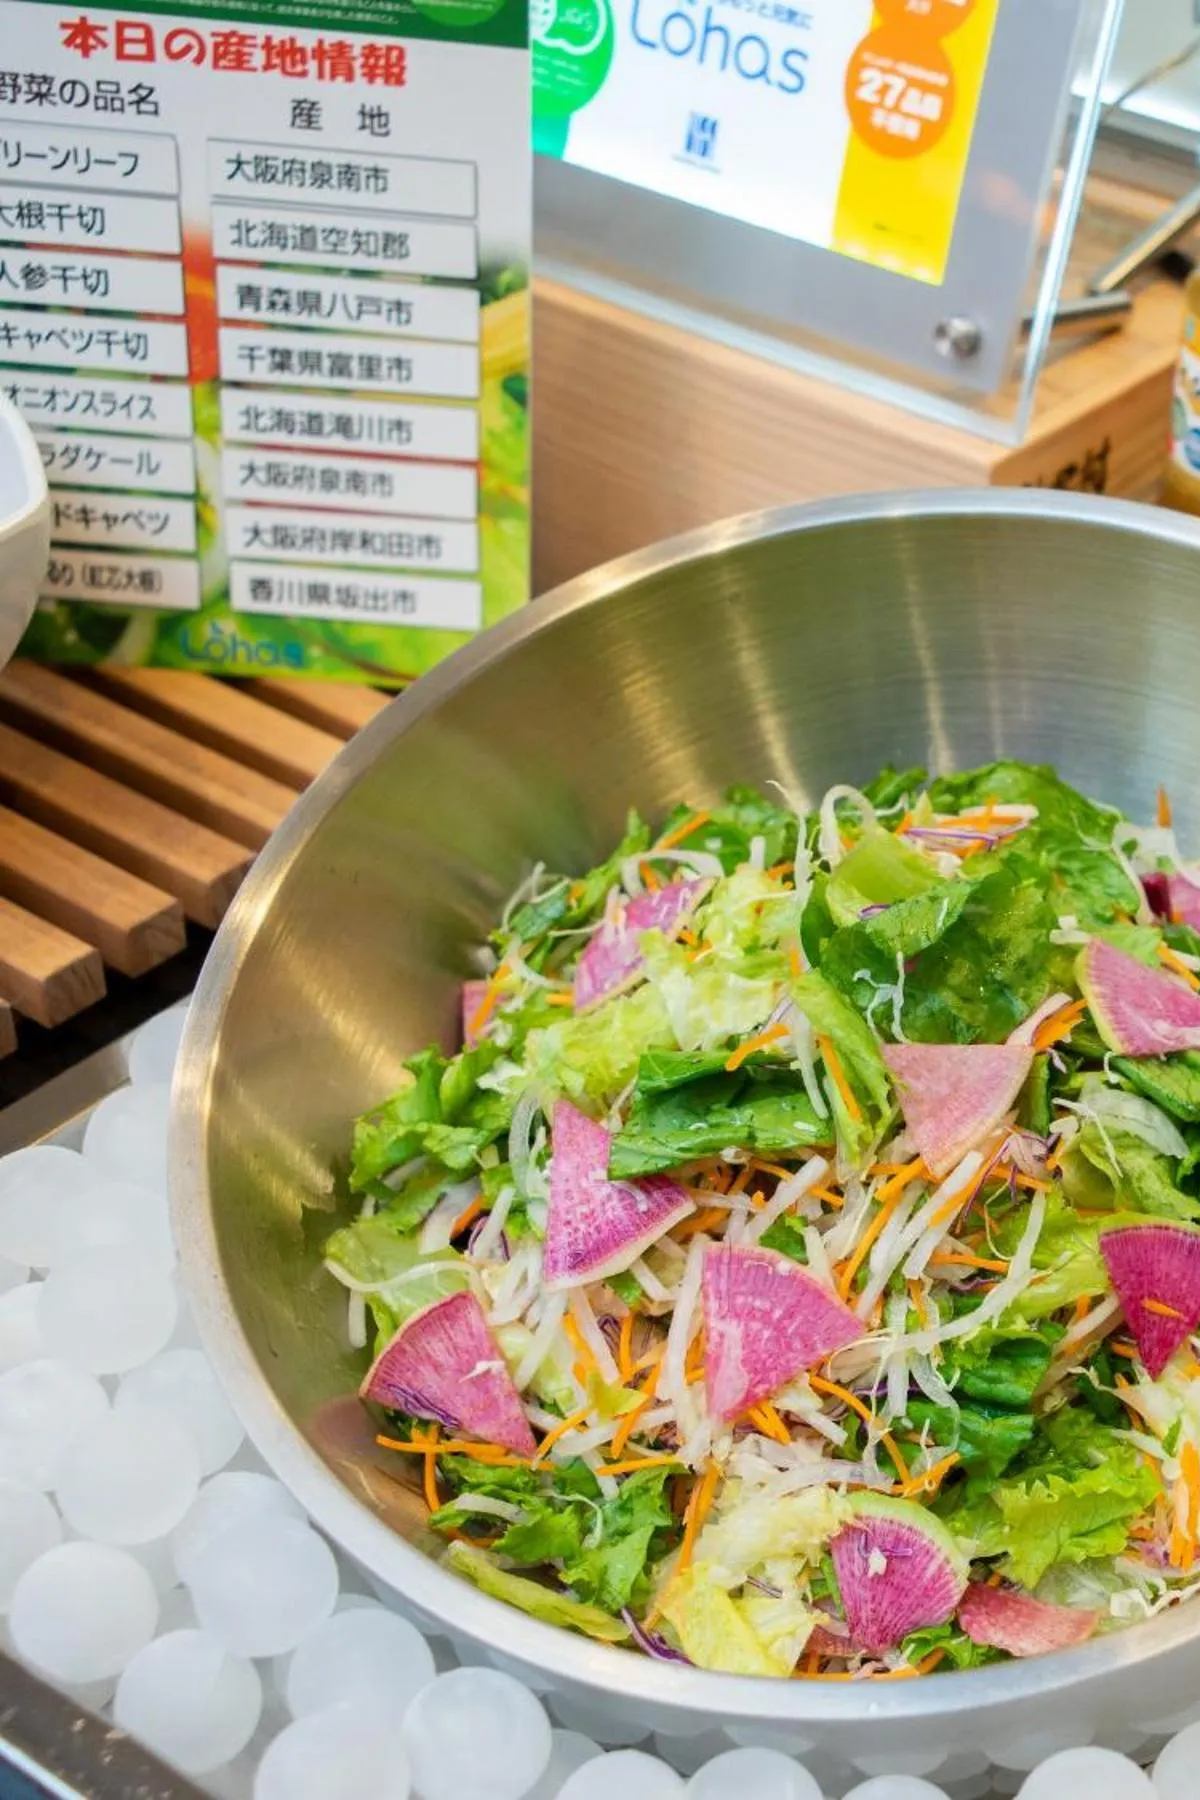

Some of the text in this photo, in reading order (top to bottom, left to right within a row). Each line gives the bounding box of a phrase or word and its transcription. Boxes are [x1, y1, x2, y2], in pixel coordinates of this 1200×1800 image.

[59, 16, 407, 87] 本日の産地情報
[631, 0, 809, 94] Lohas
[0, 72, 159, 116] 野菜の品名
[0, 138, 139, 178] リーンリーフ
[225, 153, 390, 194] 大阪府泉南市
[229, 218, 411, 261] 北海道空知郡
[0, 260, 109, 297] 人参千切
[236, 282, 414, 328] 青森県八戸市
[0, 322, 149, 361] キャベツ千切
[238, 345, 414, 383] 千葉県富里市
[238, 409, 414, 446] 北海道滝川市
[240, 460, 394, 499] 大阪府泉南市
[243, 522, 443, 560] 大阪府岸和田市
[248, 575, 418, 614] 香川県坂出市
